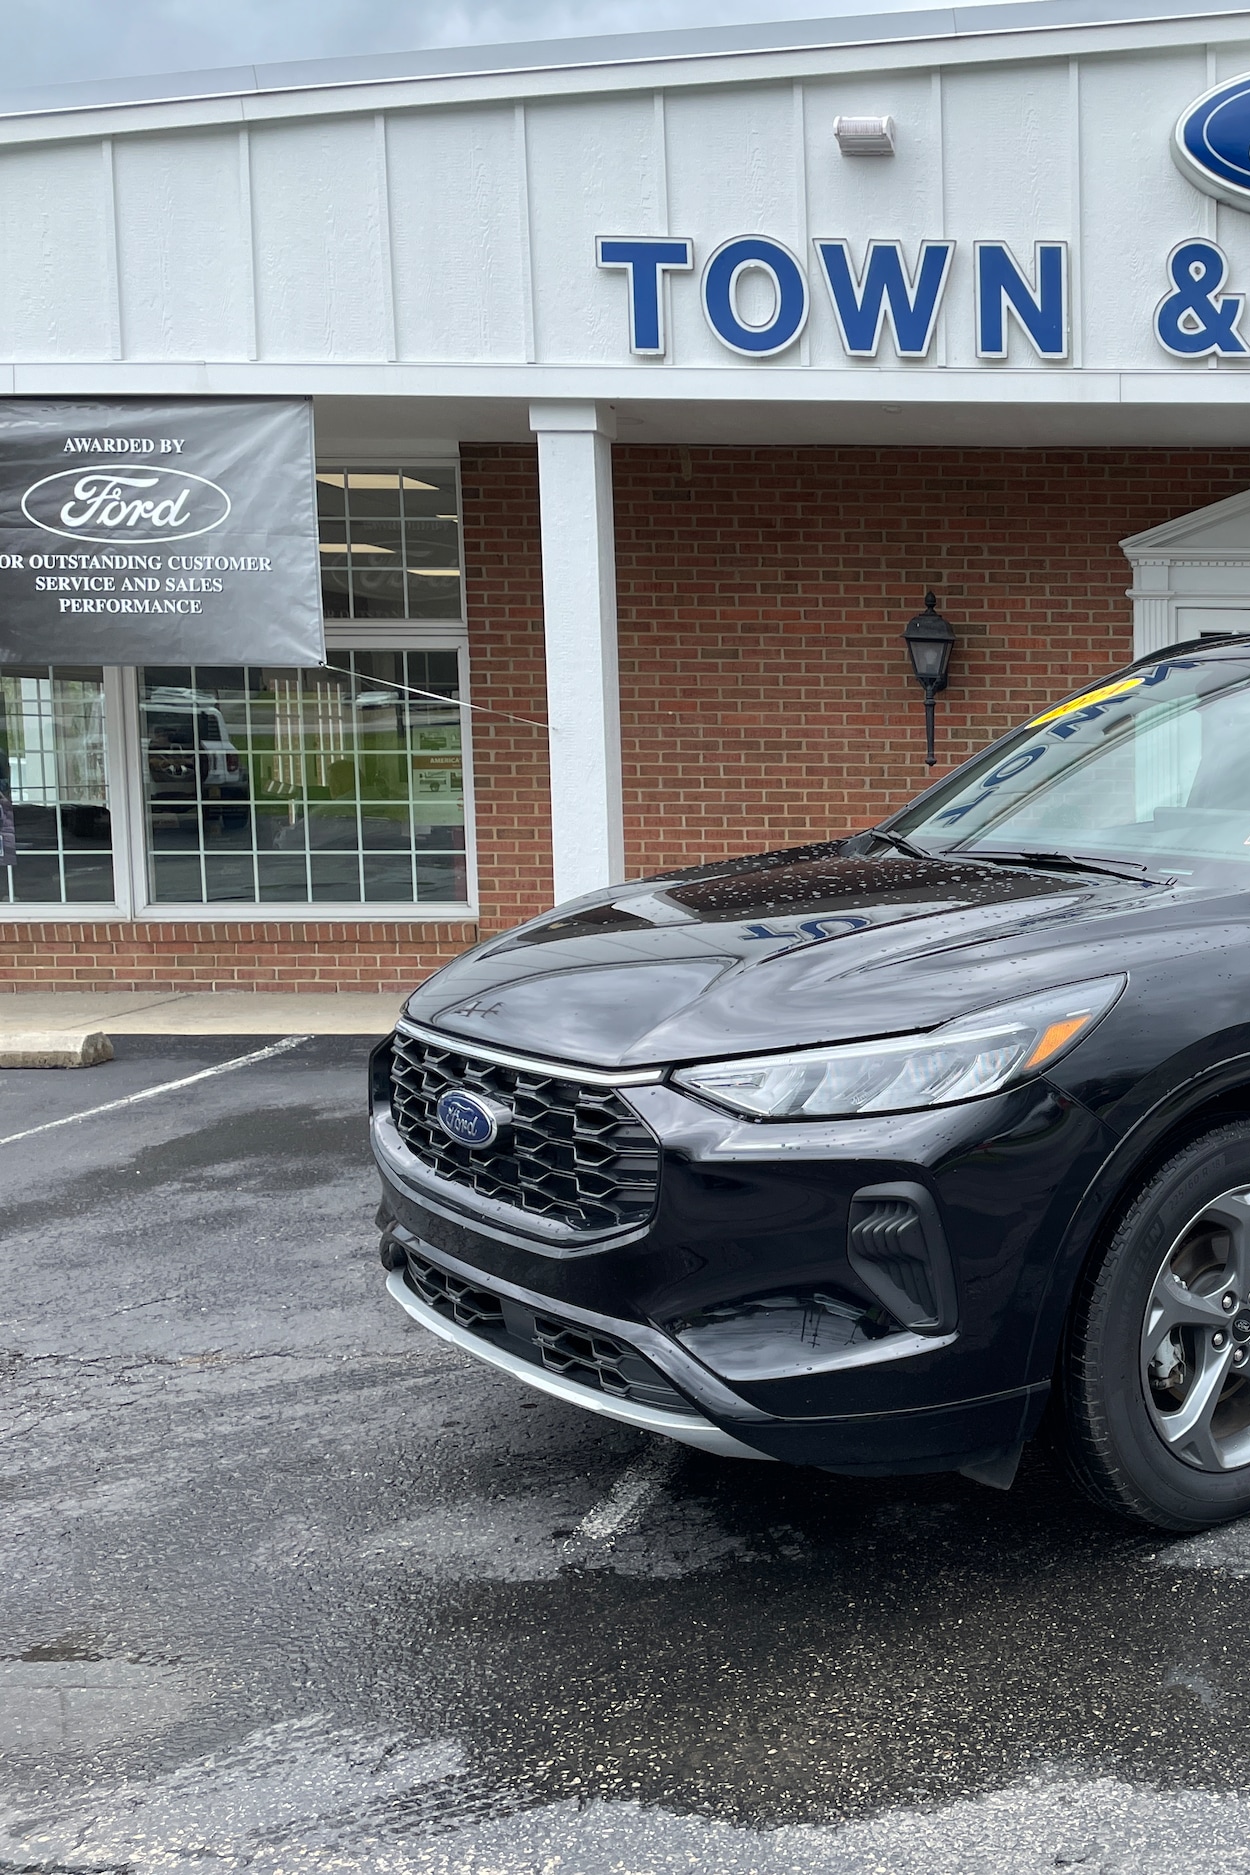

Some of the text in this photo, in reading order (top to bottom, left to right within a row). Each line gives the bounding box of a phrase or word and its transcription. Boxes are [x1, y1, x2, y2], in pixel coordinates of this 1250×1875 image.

[595, 234, 1068, 359] TOWN
[63, 437, 185, 454] AWARDED BY
[60, 475, 191, 527] Ford
[29, 555, 162, 570] OUTSTANDING
[168, 556, 272, 571] CUSTOMER
[35, 576, 223, 592] SERVICE AND SALES
[59, 598, 203, 614] PERFORMANCE
[446, 1102, 478, 1136] Ford
